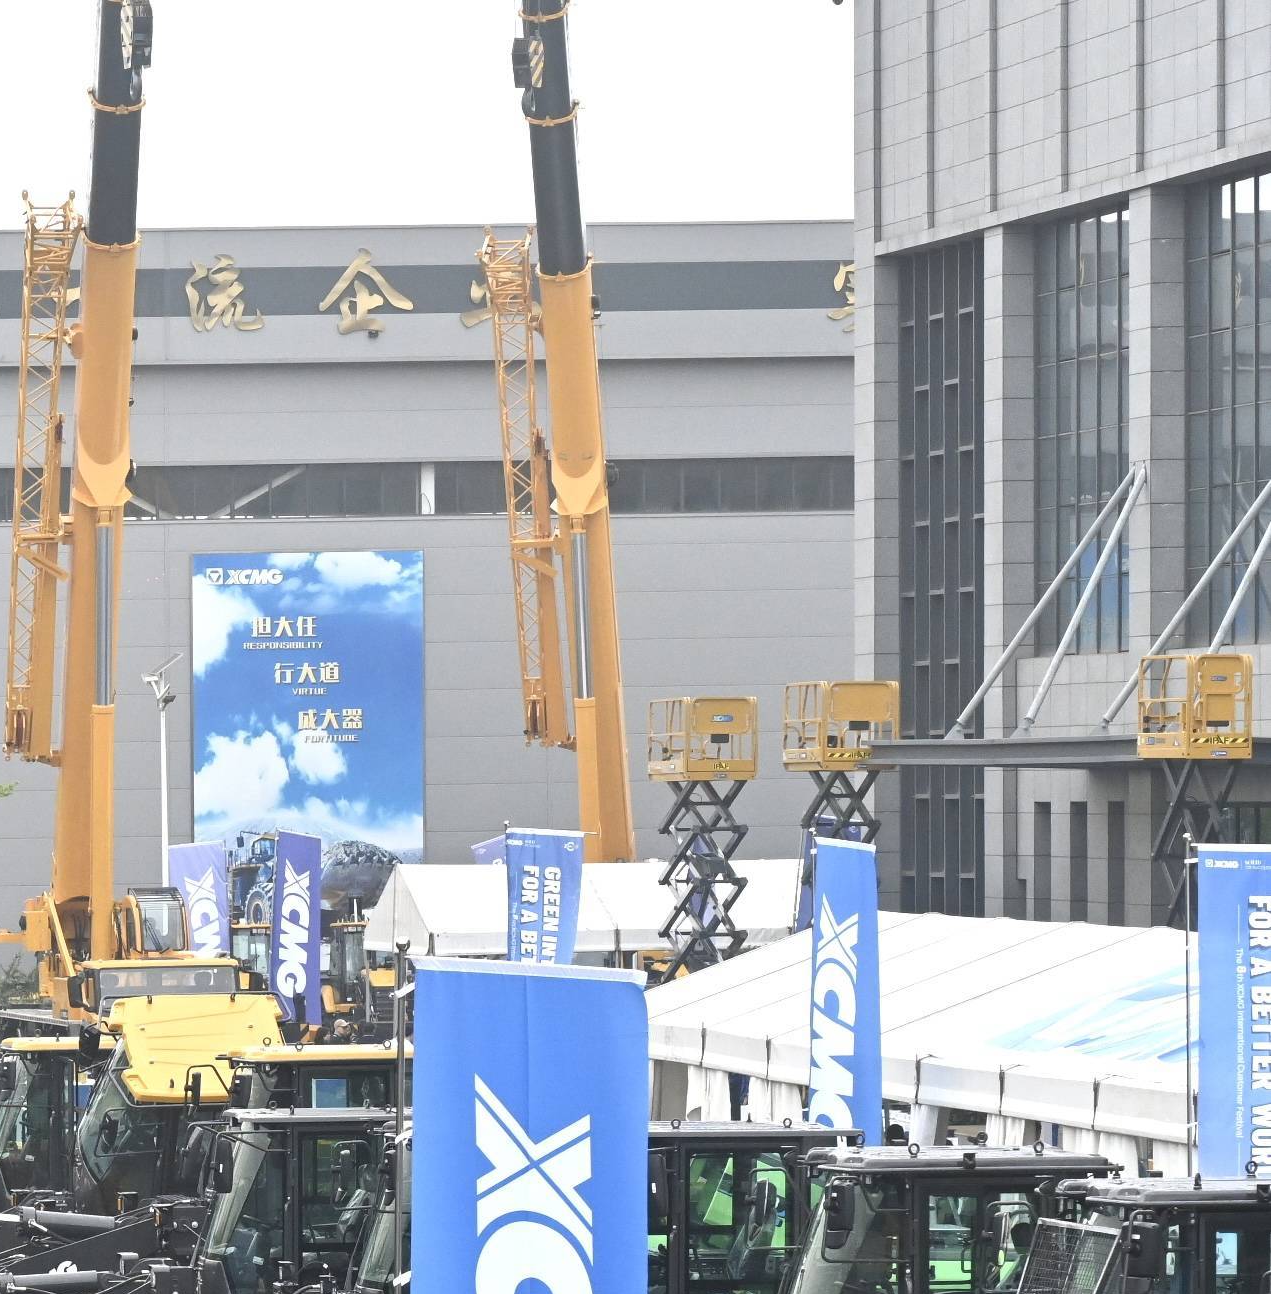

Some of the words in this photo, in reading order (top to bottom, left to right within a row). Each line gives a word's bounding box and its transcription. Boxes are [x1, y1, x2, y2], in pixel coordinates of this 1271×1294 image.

[225, 569, 283, 585] XCMG
[251, 616, 317, 638] 担大任
[243, 641, 323, 650] RESPONSIBILITY
[274, 662, 340, 684] 行大道
[292, 687, 327, 696] VIRTUE
[298, 708, 363, 730] 成大器
[304, 734, 359, 743] FORTITUDE
[521, 865, 539, 904] FOR
[542, 866, 561, 932] GREEN
[520, 909, 539, 924] A
[1248, 895, 1271, 948] FOR
[277, 859, 310, 999] XCMG
[1250, 985, 1271, 1092] BETTER
[1234, 1107, 1244, 1138] Festival
